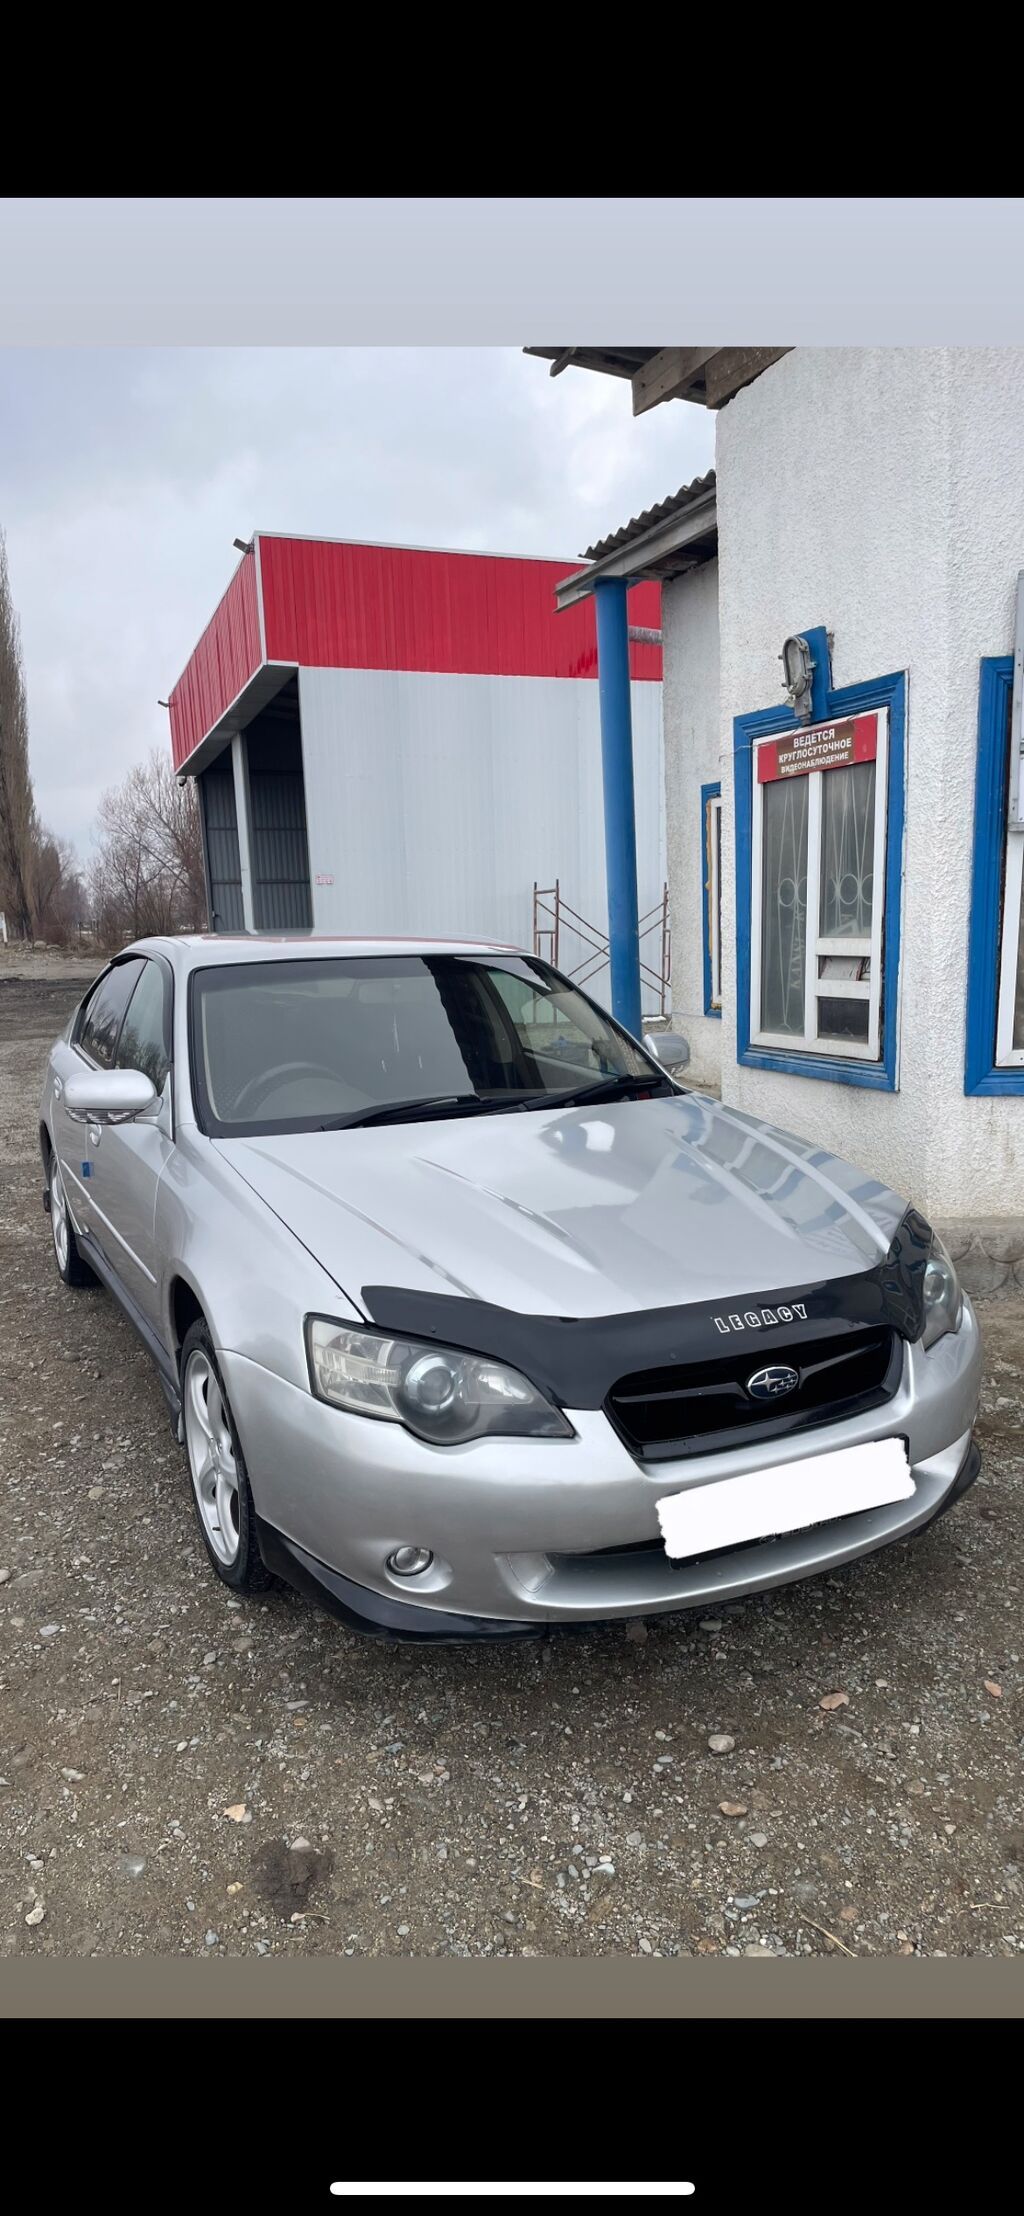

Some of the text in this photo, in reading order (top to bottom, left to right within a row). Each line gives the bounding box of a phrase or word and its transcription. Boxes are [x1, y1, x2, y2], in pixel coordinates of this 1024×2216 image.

[778, 737, 852, 763] КРУГЛОСУТОЧНОЕ
[793, 728, 835, 748] ВЕДЕТСЯ
[781, 751, 849, 773] ВИДЕОНАБЛЮДЕНИЕ
[714, 1304, 808, 1333] LEGACY
